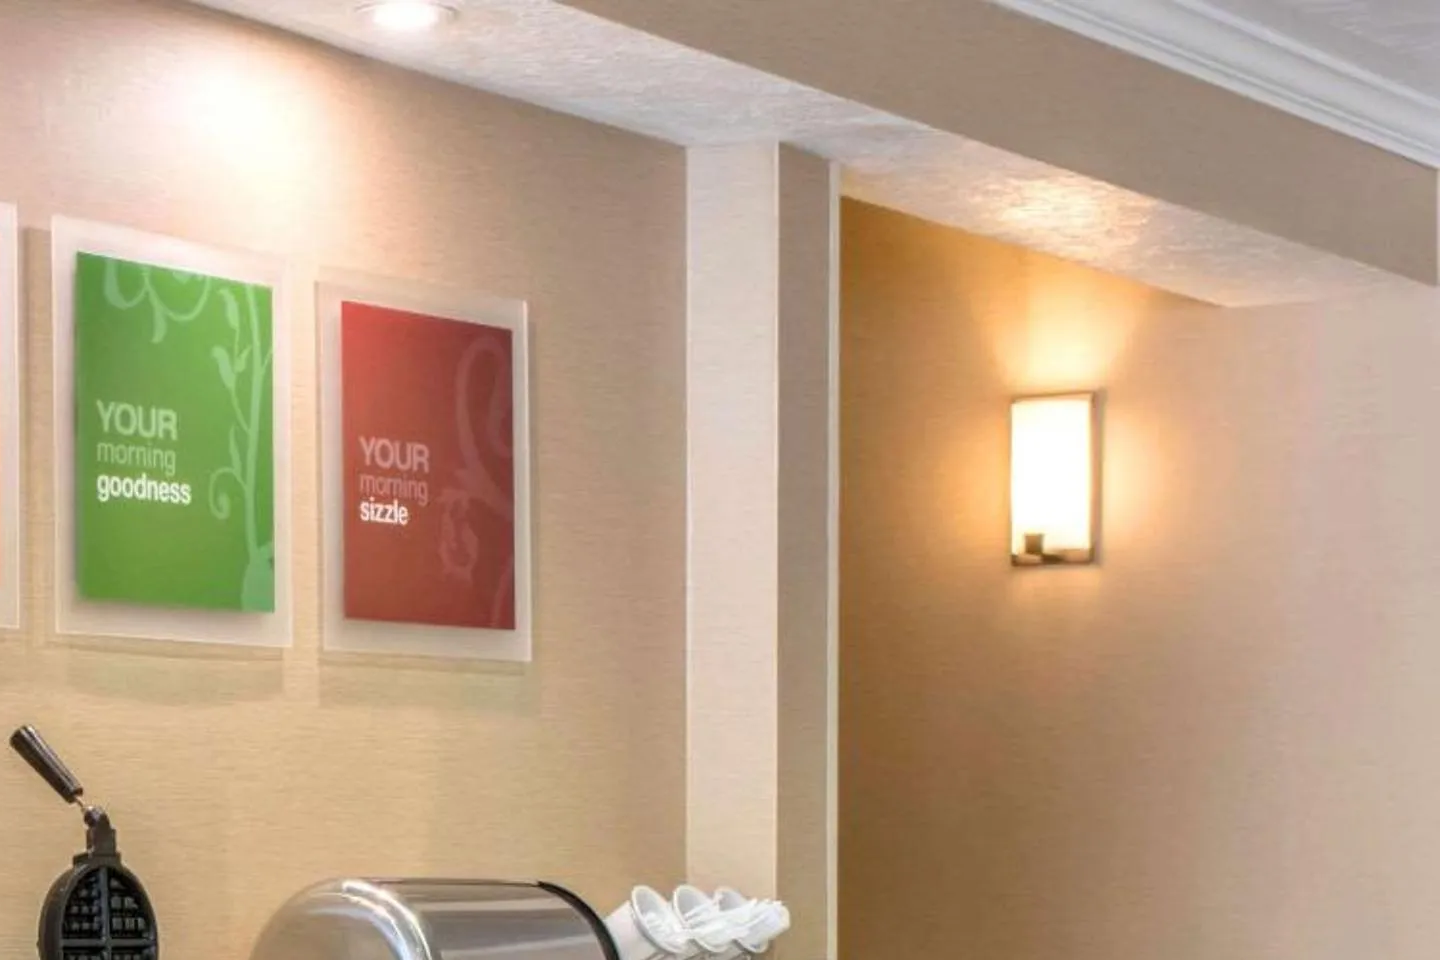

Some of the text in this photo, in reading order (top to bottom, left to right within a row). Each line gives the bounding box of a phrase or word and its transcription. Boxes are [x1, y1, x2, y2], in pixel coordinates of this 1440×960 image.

[96, 399, 179, 441] YOUR
[96, 441, 177, 478] morning
[358, 435, 430, 474] YOUR
[96, 472, 192, 505] goodness
[359, 473, 428, 507] morning
[359, 496, 409, 526] sizzle
